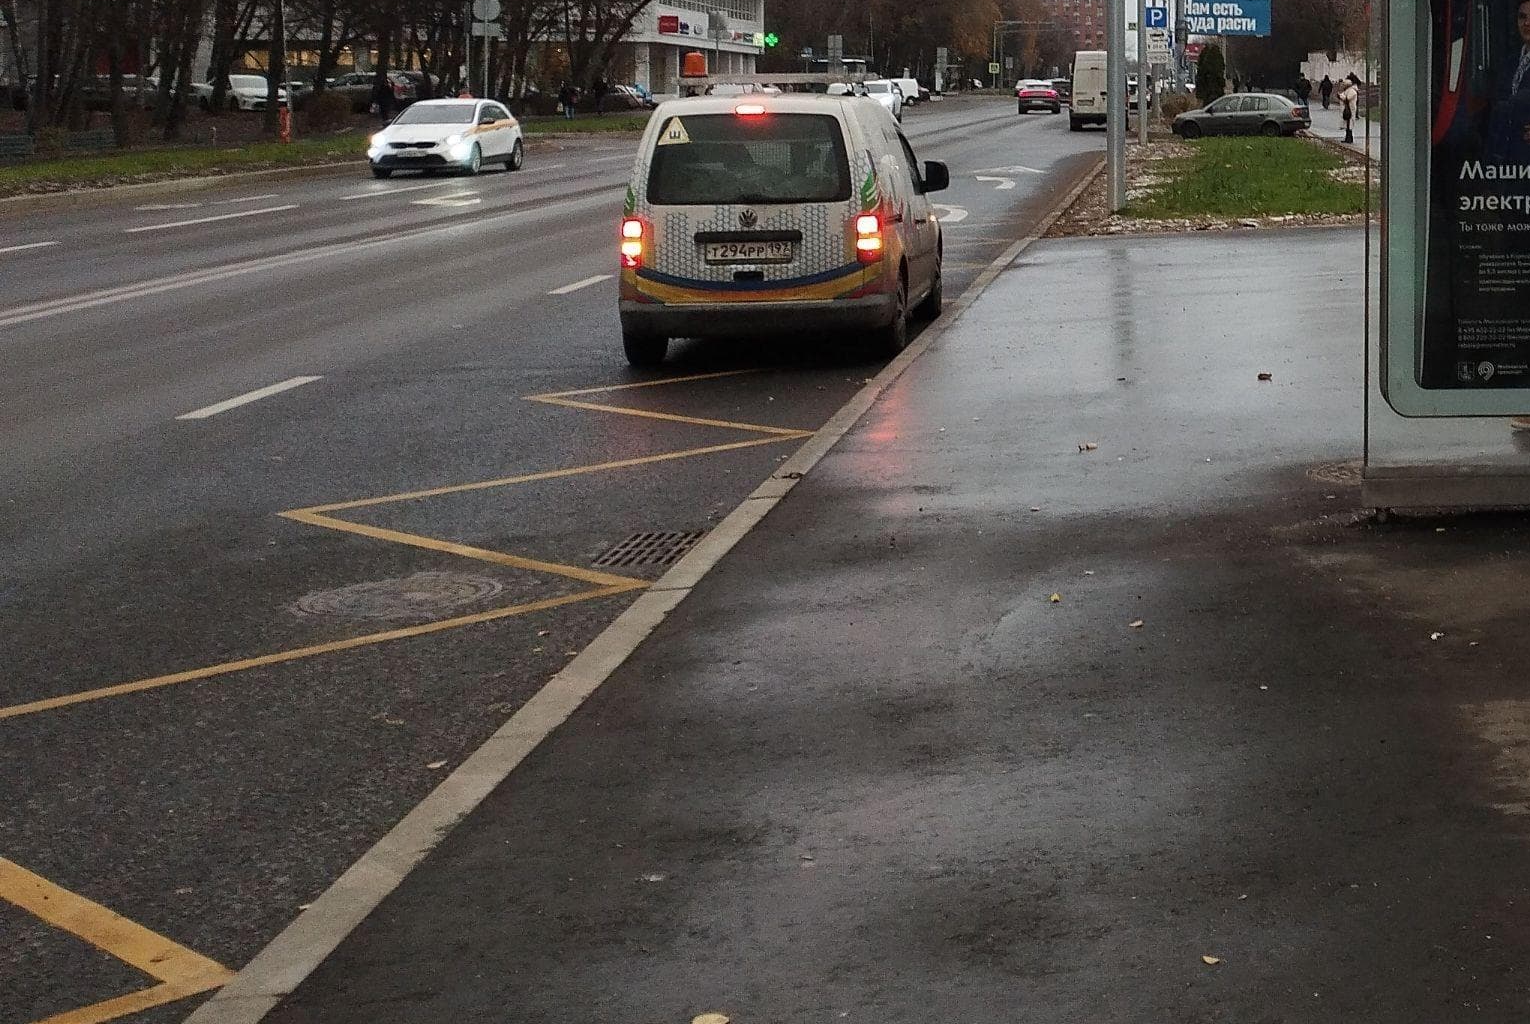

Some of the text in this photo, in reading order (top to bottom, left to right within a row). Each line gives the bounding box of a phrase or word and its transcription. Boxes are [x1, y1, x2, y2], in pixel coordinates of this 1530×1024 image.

[1213, 3, 1243, 16] есть
[1150, 9, 1163, 26] P
[1218, 17, 1256, 33] расти
[669, 130, 681, 140] Ш
[1459, 221, 1473, 232] Ты
[1476, 223, 1504, 232] тоже
